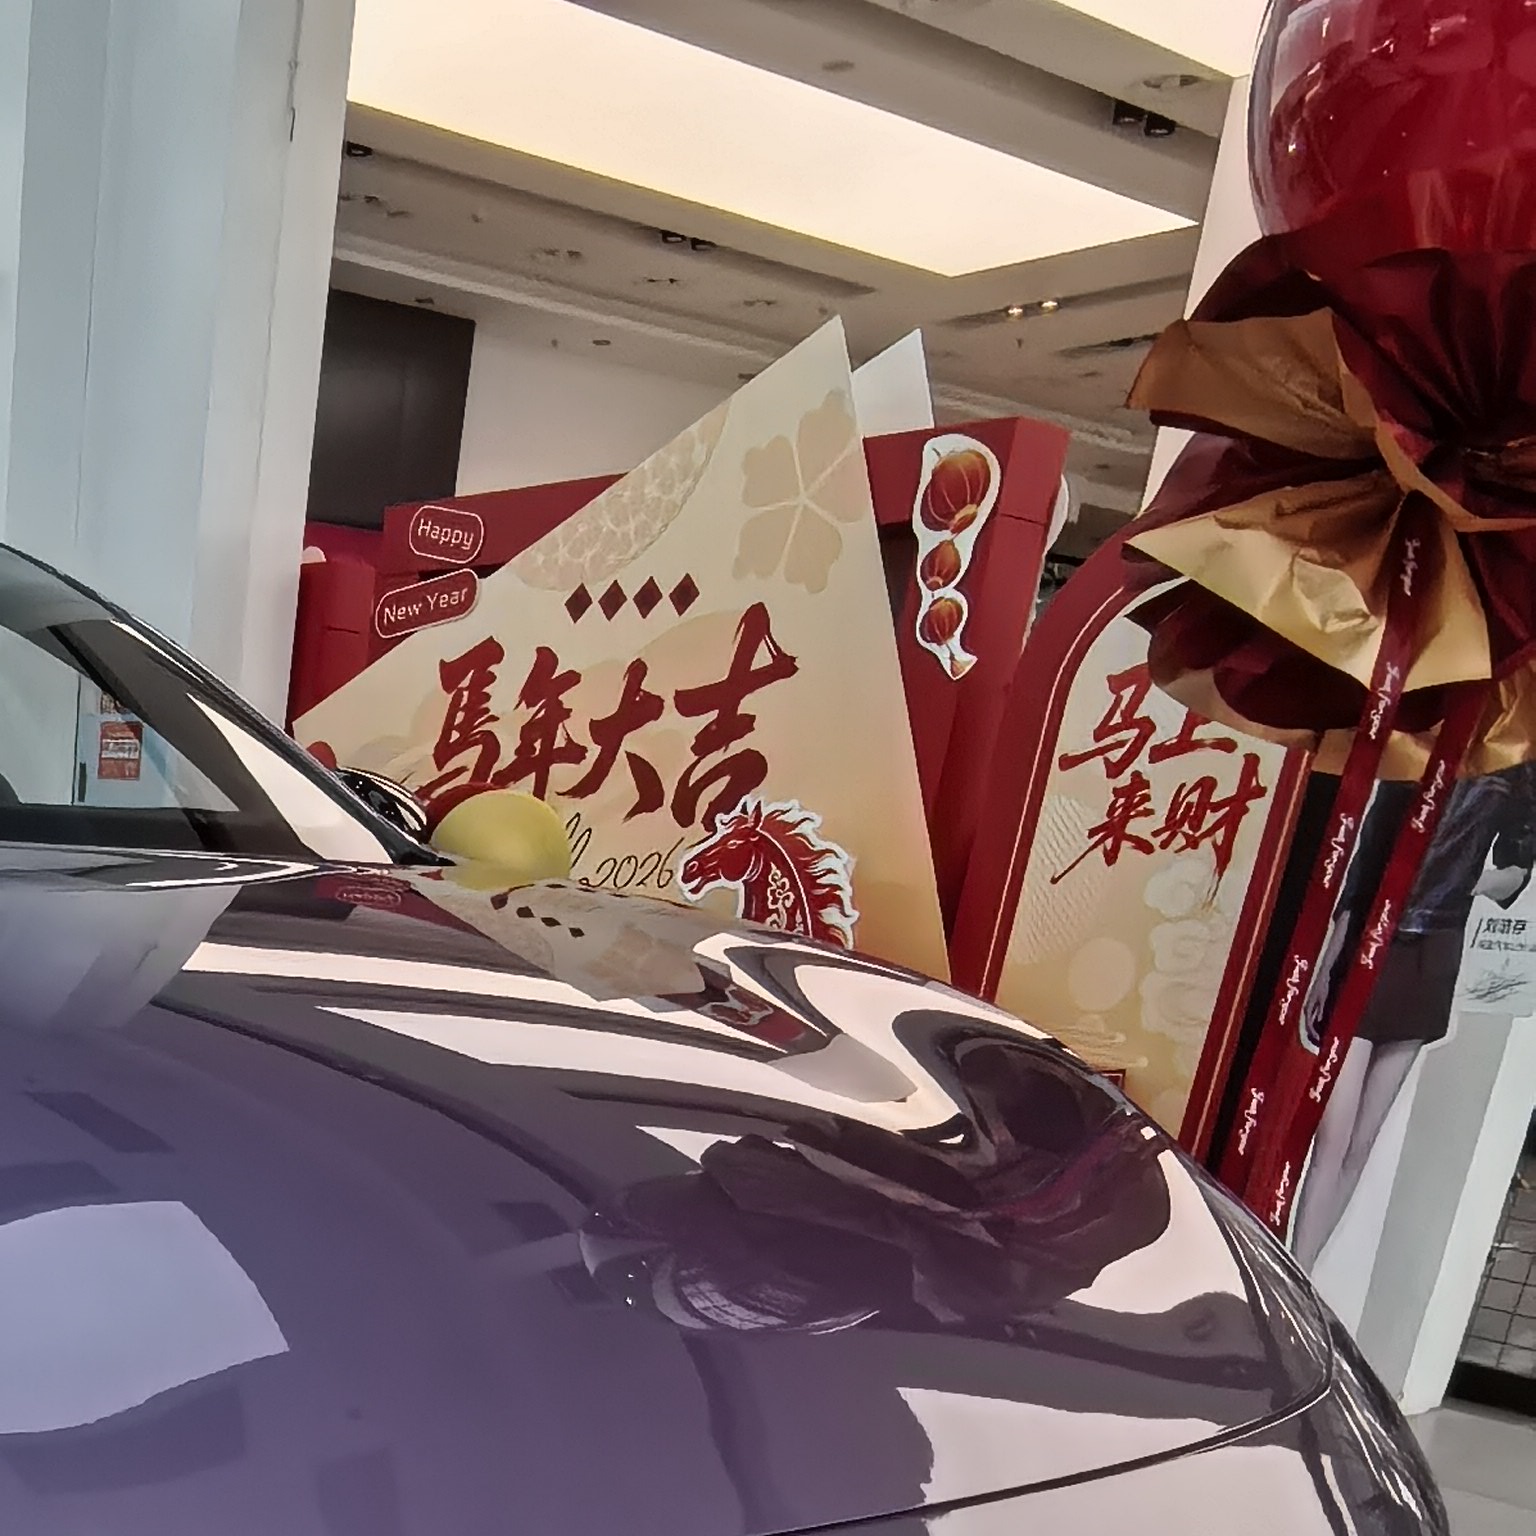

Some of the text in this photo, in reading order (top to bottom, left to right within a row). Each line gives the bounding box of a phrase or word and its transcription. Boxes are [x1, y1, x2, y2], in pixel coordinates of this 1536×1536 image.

[417, 518, 474, 550] Happy
[383, 587, 468, 626] New Year
[417, 602, 800, 832] 馬年大吉
[1058, 662, 1238, 779] 马上
[578, 837, 685, 889] 2026
[1050, 753, 1268, 906] 来财
